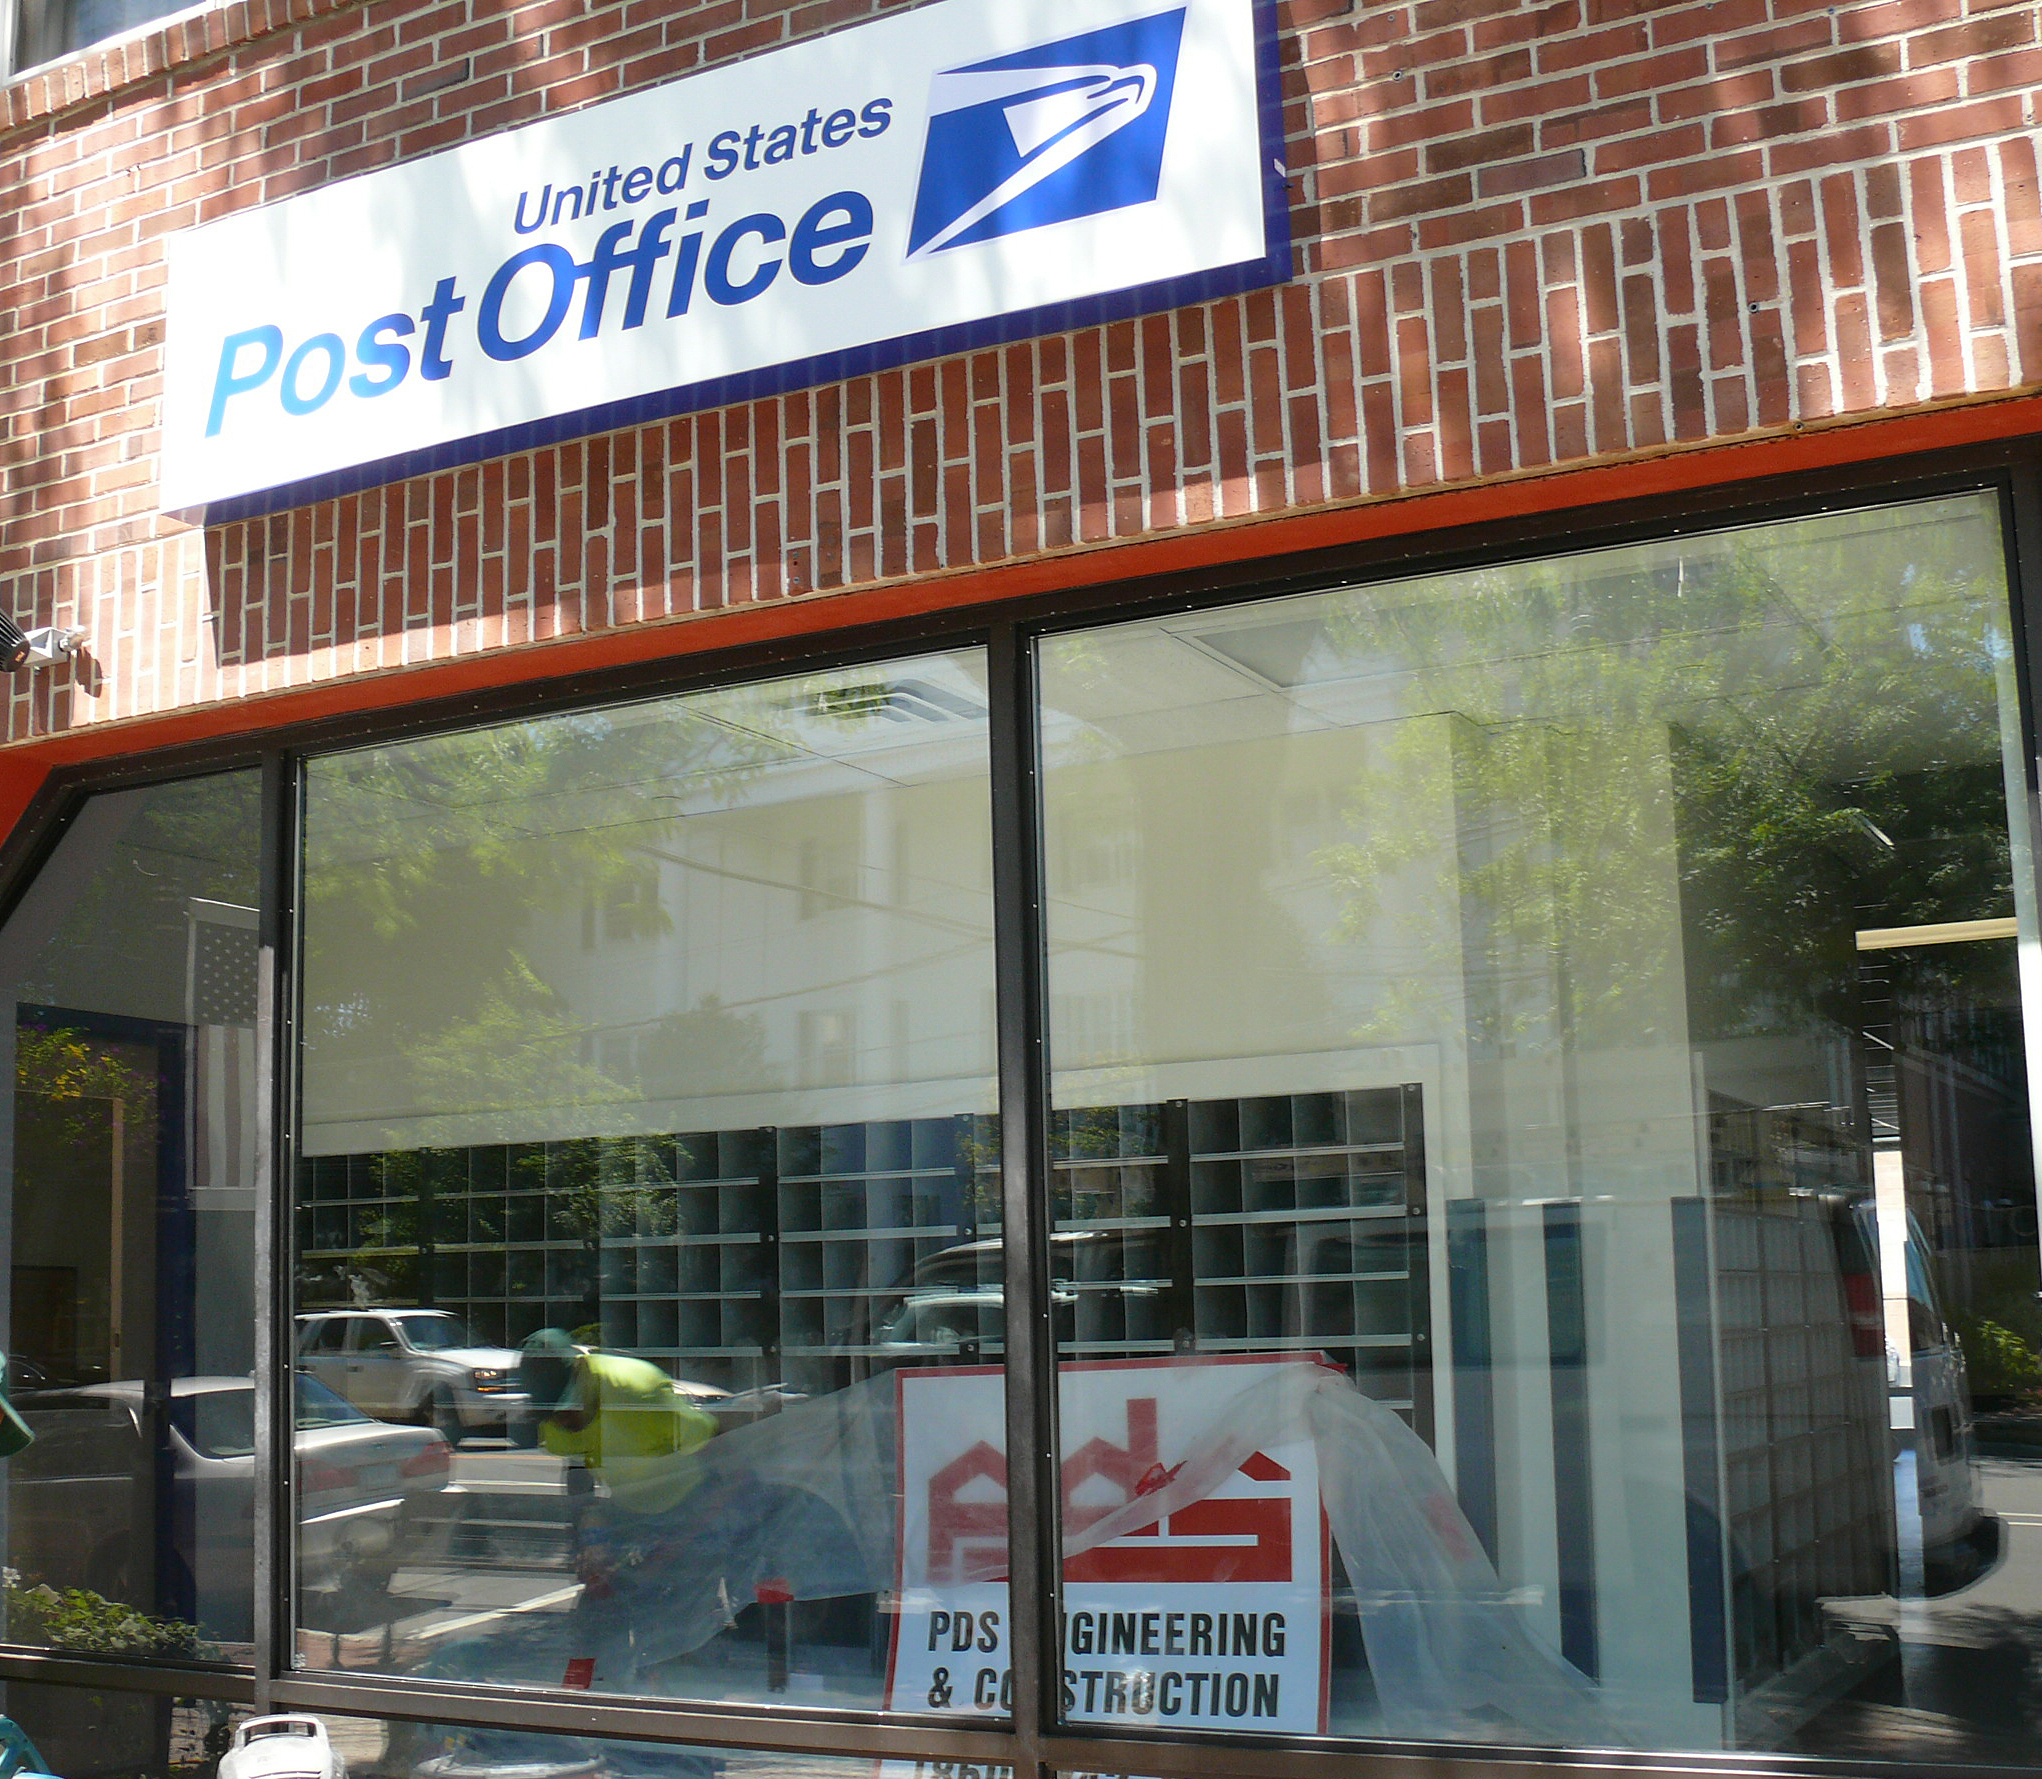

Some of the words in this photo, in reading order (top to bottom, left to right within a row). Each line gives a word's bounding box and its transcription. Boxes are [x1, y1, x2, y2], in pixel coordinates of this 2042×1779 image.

[513, 142, 694, 236] United
[702, 97, 893, 182] States
[205, 276, 467, 437] Post
[476, 190, 875, 363] Office
[926, 1610, 1000, 1655] PDS
[1063, 1610, 1287, 1658] GINEERING
[926, 1665, 954, 1709] &
[974, 1667, 1281, 1719] COSTRUCTION
